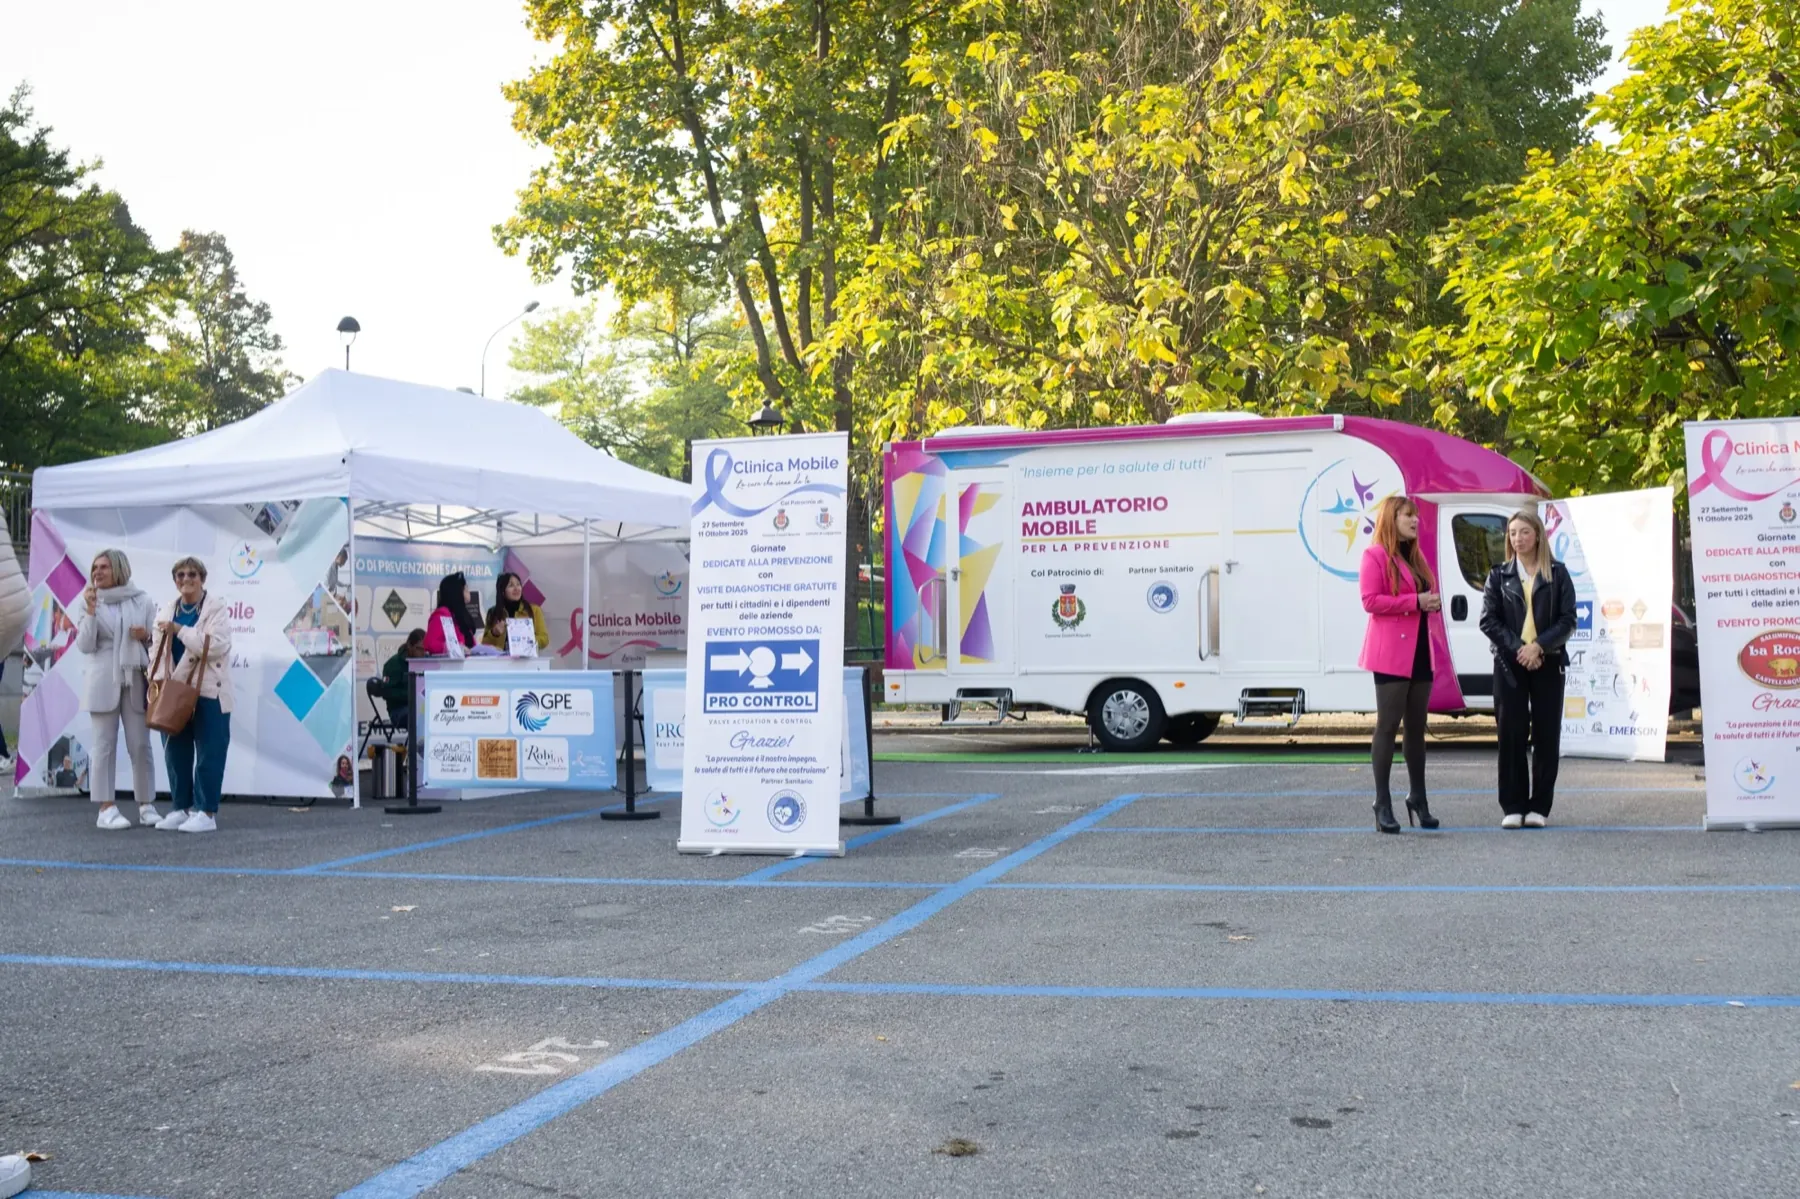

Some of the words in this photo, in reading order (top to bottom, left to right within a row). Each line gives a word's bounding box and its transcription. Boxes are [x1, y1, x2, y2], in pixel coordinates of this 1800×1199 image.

[1734, 441, 1789, 456] Clinica
[733, 459, 784, 474] Clinica
[788, 456, 839, 471] Mobile
[1077, 465, 1099, 479] per
[1103, 462, 1115, 474] la
[1119, 460, 1160, 474] salute
[1163, 459, 1175, 472] di
[1022, 496, 1169, 517] AMBULATORIO
[712, 520, 744, 528] Settembre
[1022, 519, 1097, 537] MOBILE
[731, 528, 748, 536] 2025
[1757, 533, 1796, 542] Giornate
[750, 544, 786, 553] Giornate
[1022, 544, 1047, 554] PER
[1053, 543, 1068, 553] LA
[1075, 540, 1170, 552] PREVENZIONE
[1705, 547, 1754, 557] DEDICATE
[1756, 547, 1780, 555] ALLA
[703, 559, 746, 568] DEDICATE
[748, 558, 769, 567] ALLA
[771, 555, 833, 566] PREVENZIONE
[1769, 560, 1786, 568] con
[367, 560, 376, 572] DI
[379, 560, 445, 575] PREVENZIONE
[1031, 569, 1045, 578] Col
[1048, 568, 1091, 577] Patrocinio
[1094, 568, 1104, 576] di:
[1129, 566, 1157, 574] Partner
[1159, 565, 1194, 574] Sanitario
[758, 571, 773, 579] con
[1701, 574, 1731, 583] VISITE
[1734, 572, 1800, 582] DIAGNOSTICH
[697, 586, 724, 595] VISITE
[726, 584, 792, 594] DIAGNOSTICHE
[794, 582, 837, 591] GRATUITE
[1708, 591, 1722, 600] per
[1725, 588, 1743, 598] tutti
[1751, 587, 1787, 597] cittadini
[700, 602, 714, 611] per
[716, 601, 733, 610] tutti
[740, 599, 772, 608] cittadini
[786, 598, 831, 609] dipendenti
[1751, 600, 1773, 608] delle
[1776, 599, 1800, 607] azien
[228, 602, 255, 620] ile
[739, 612, 758, 621] delle
[760, 611, 793, 620] aziende
[589, 613, 632, 628] Clinica
[635, 612, 682, 626] Mobile
[1717, 618, 1760, 628] EVENTO
[1763, 617, 1800, 627] PROMO
[707, 627, 745, 636] EVENTO
[748, 626, 804, 636] PROMOSSO
[806, 625, 822, 634] DA:
[1760, 633, 1800, 642] SALUMIFICI
[1749, 645, 1767, 656] La
[1773, 644, 1800, 656] Roc
[541, 693, 572, 710] GPE
[709, 696, 739, 708] PRO
[743, 695, 813, 707] CONTROL
[1752, 692, 1800, 712] Graz
[1738, 720, 1781, 729] prevenzione
[1609, 726, 1658, 736] EMERSON
[1722, 732, 1744, 740] salute
[1754, 731, 1770, 739] tutti
[1782, 730, 1800, 739] futur
[729, 730, 795, 751] Grazie!
[716, 755, 755, 764] prevenzione
[729, 766, 744, 774] tutti
[754, 766, 775, 774] futuro
